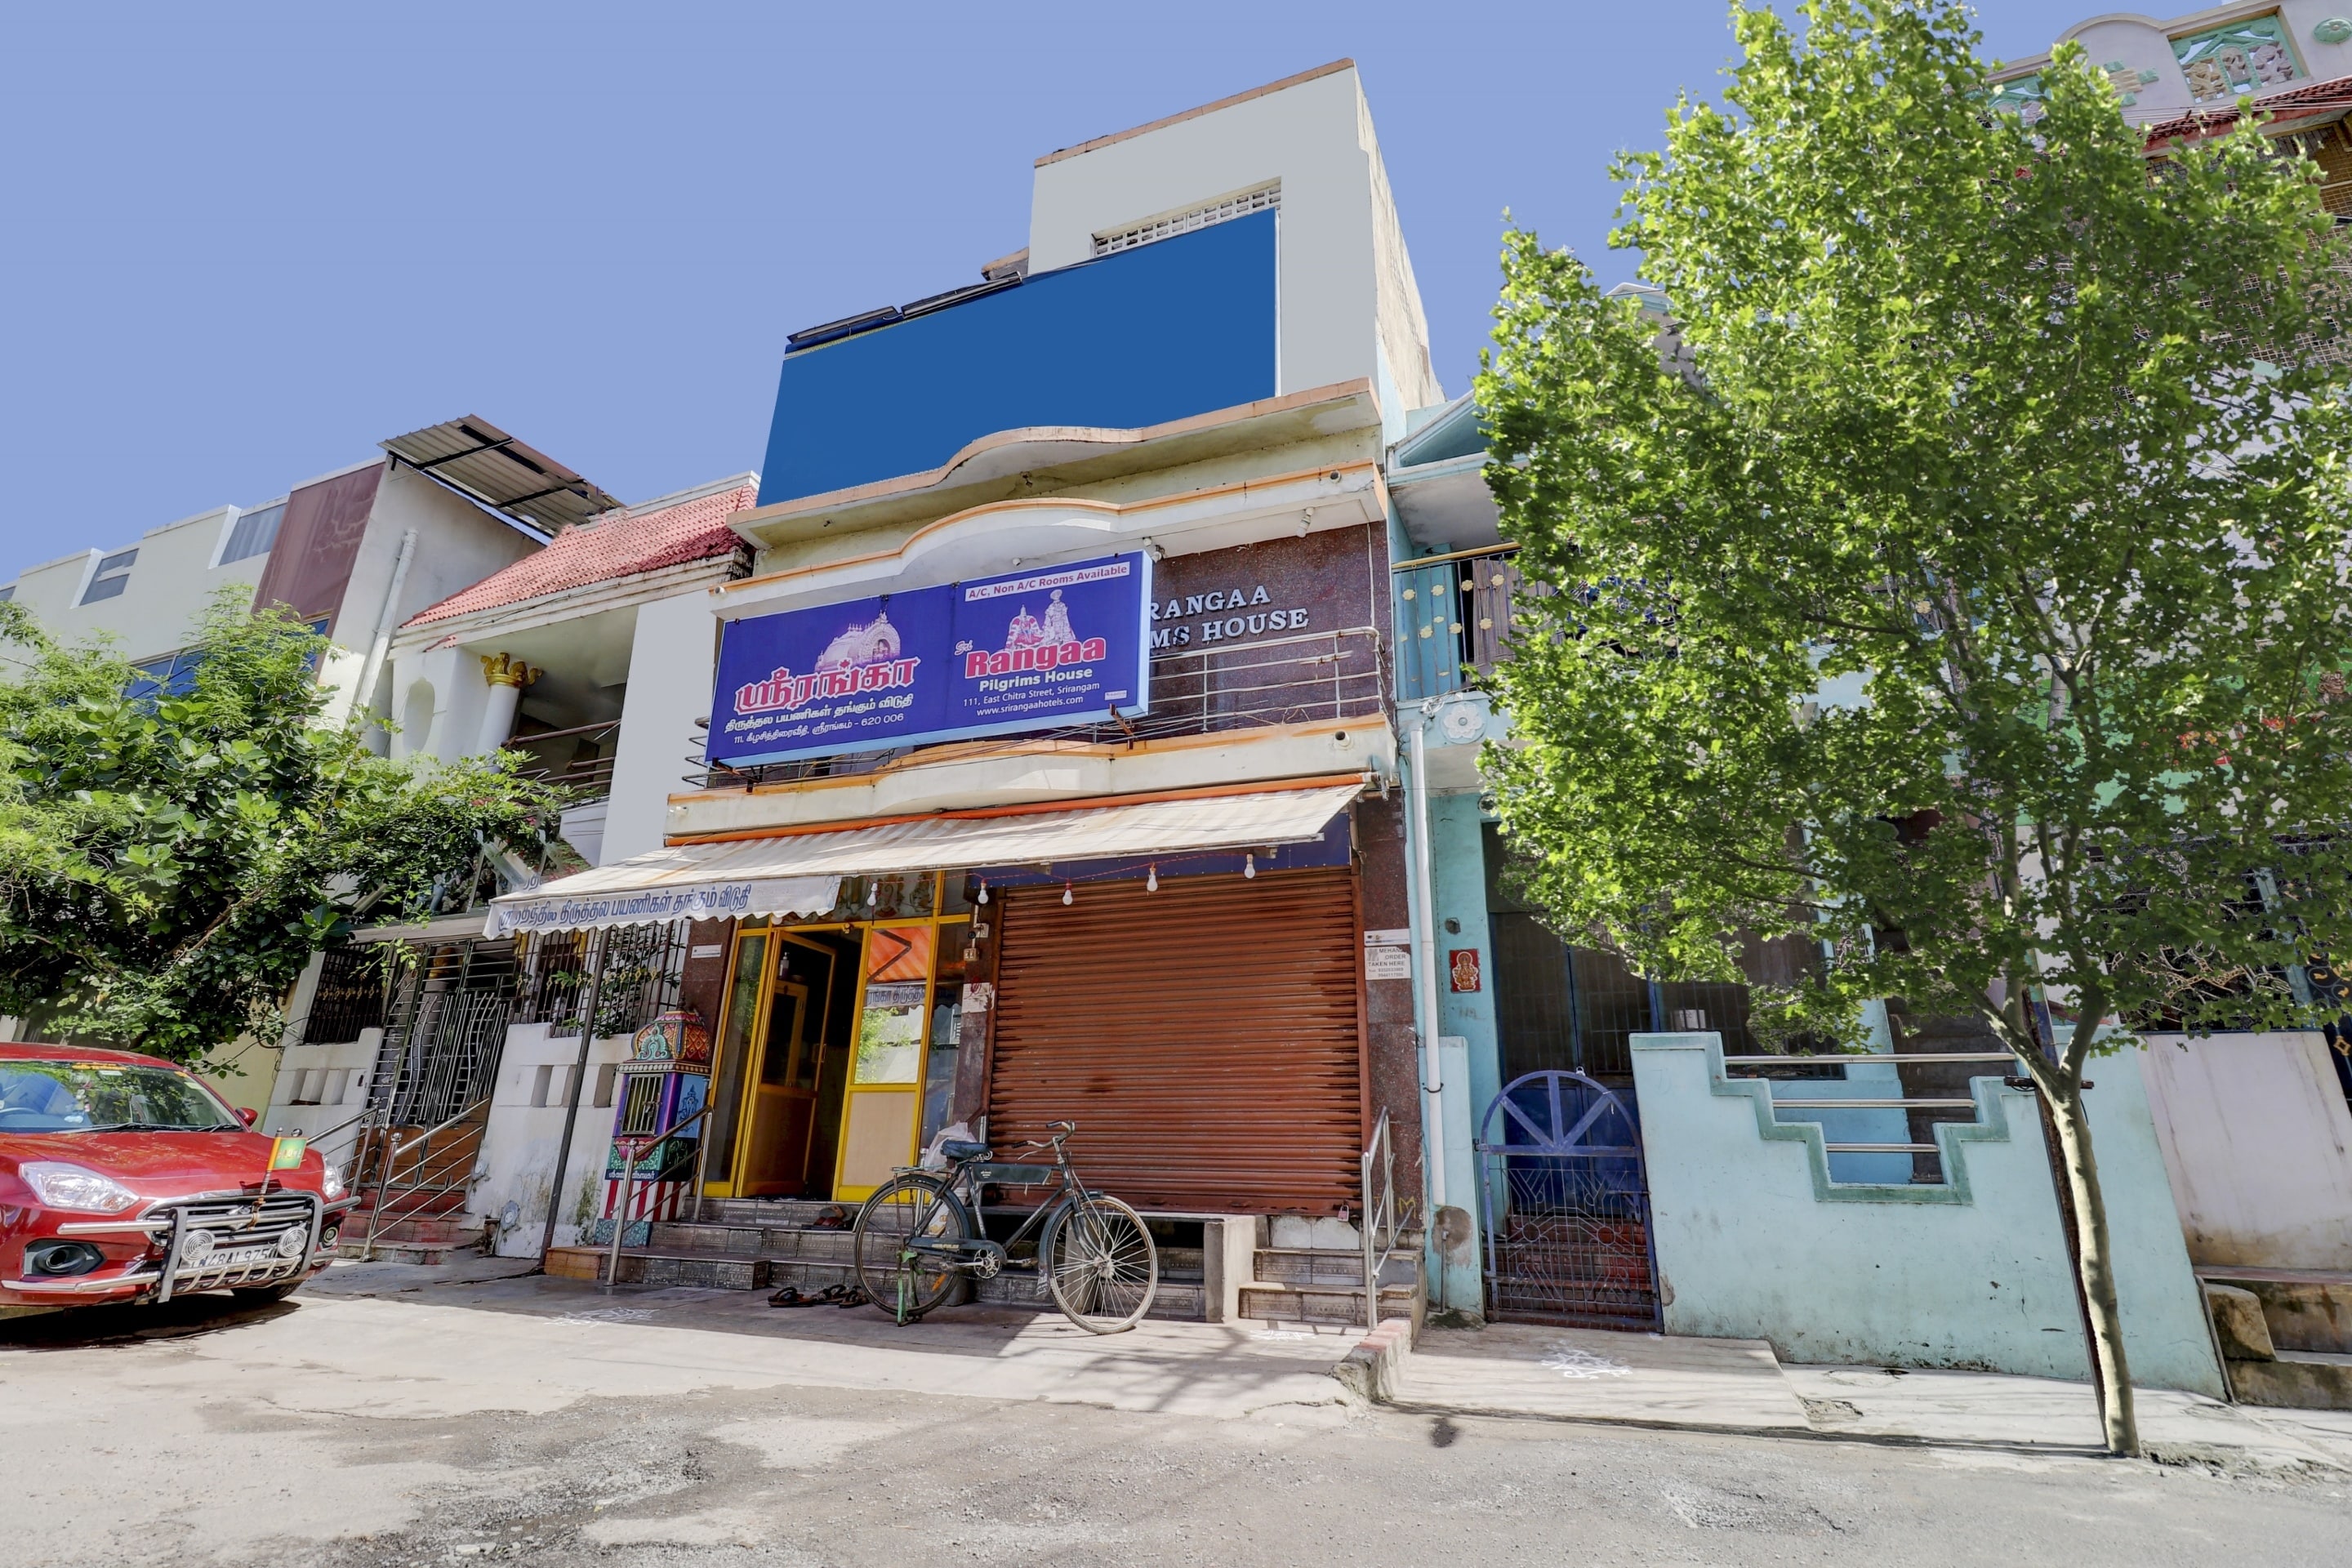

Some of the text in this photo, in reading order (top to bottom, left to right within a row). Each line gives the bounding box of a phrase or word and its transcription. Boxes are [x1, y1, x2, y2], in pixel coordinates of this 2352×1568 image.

[969, 566, 1127, 599] A/C, Non A/C Rooms Available
[1151, 585, 1272, 621] RANGAA
[1201, 608, 1309, 643] HOUSE
[954, 639, 973, 656] Sri
[964, 637, 1107, 679] Rangaa
[963, 698, 981, 707] 111,
[983, 695, 1000, 704] East
[1002, 691, 1027, 702] Chitra
[1028, 688, 1054, 698] Street,
[1057, 682, 1100, 696] Srirangam
[979, 667, 1093, 693] Pilgrims House
[724, 693, 914, 733] திருத்தல பயணிகள் தங்கும் விடுதி
[862, 717, 881, 727] 620
[883, 713, 904, 724] 006
[977, 696, 1084, 716] www.srirangaahotels.com
